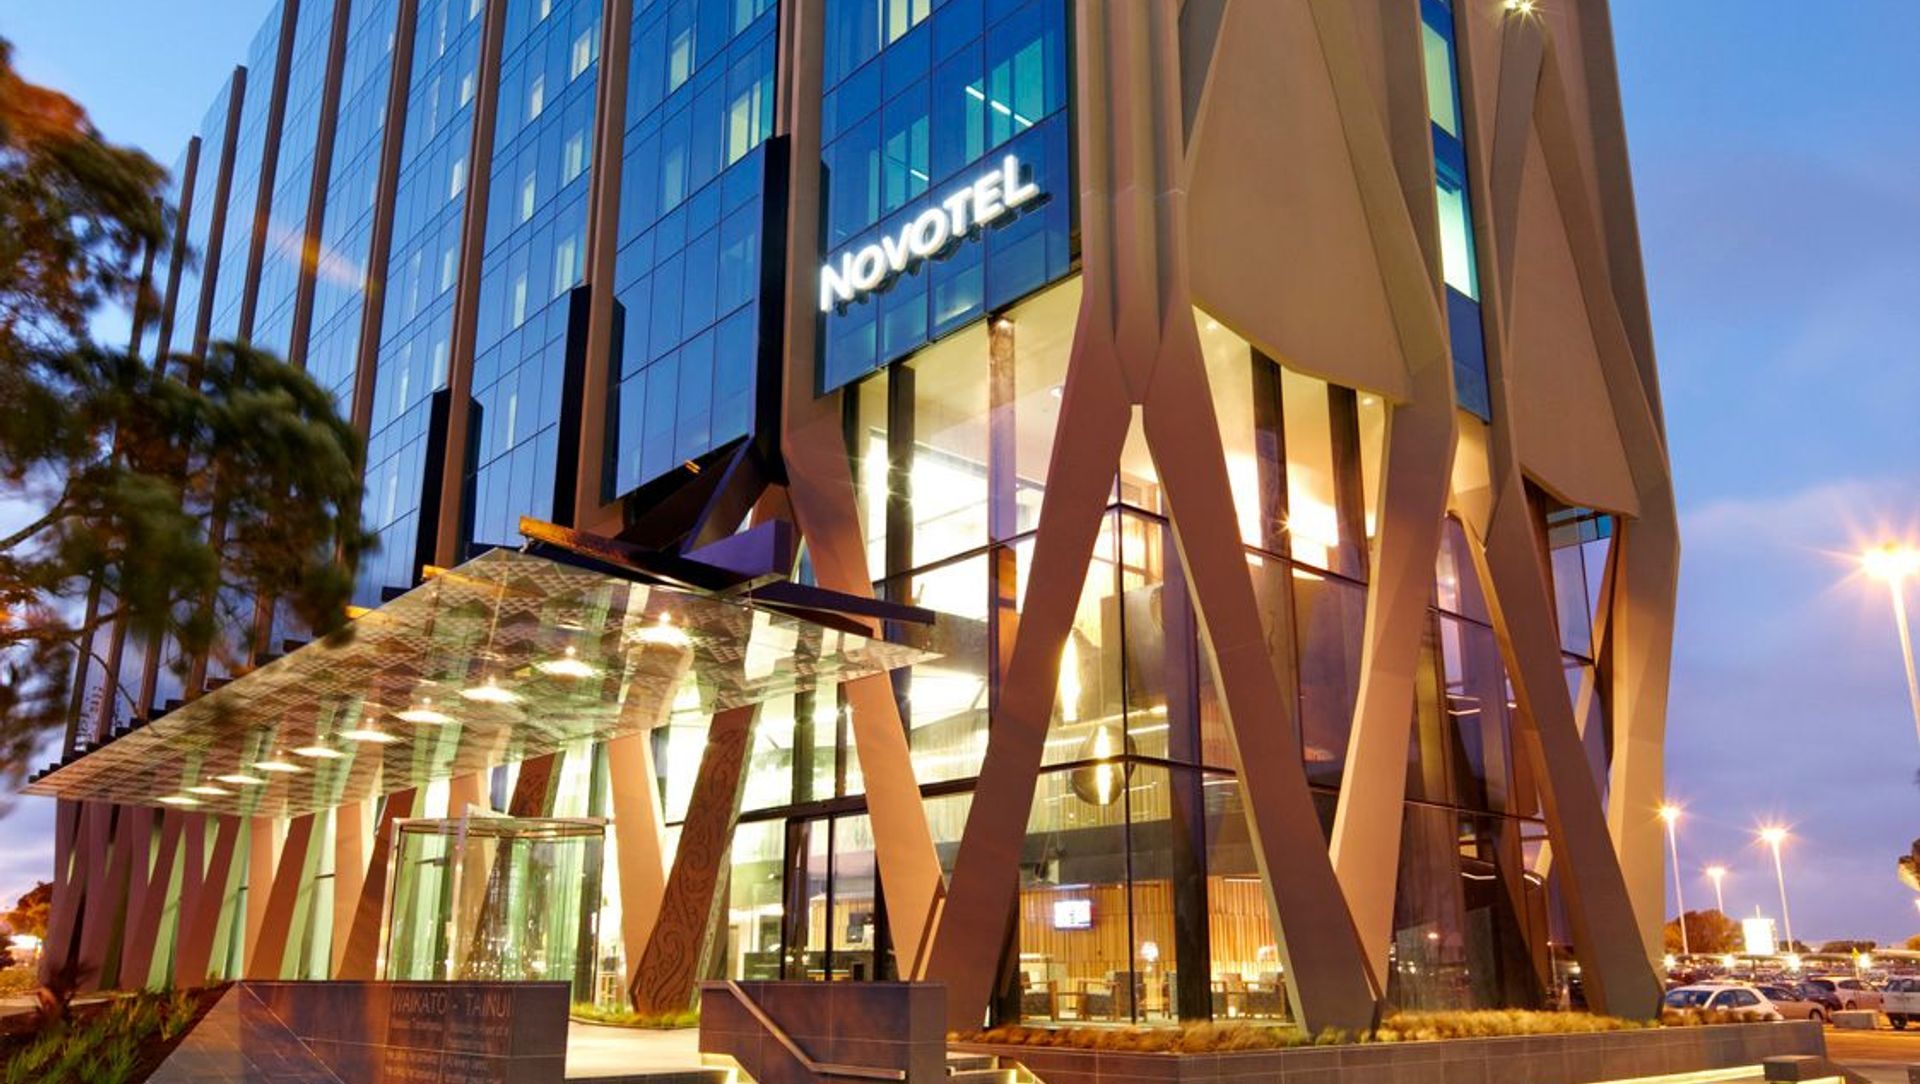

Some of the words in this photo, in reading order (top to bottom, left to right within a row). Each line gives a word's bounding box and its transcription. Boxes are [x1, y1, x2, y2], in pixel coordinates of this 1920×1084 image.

[820, 154, 1040, 312] NOVOTEL
[393, 991, 447, 1015] WAIKATO
[465, 993, 511, 1018] TAINUI
